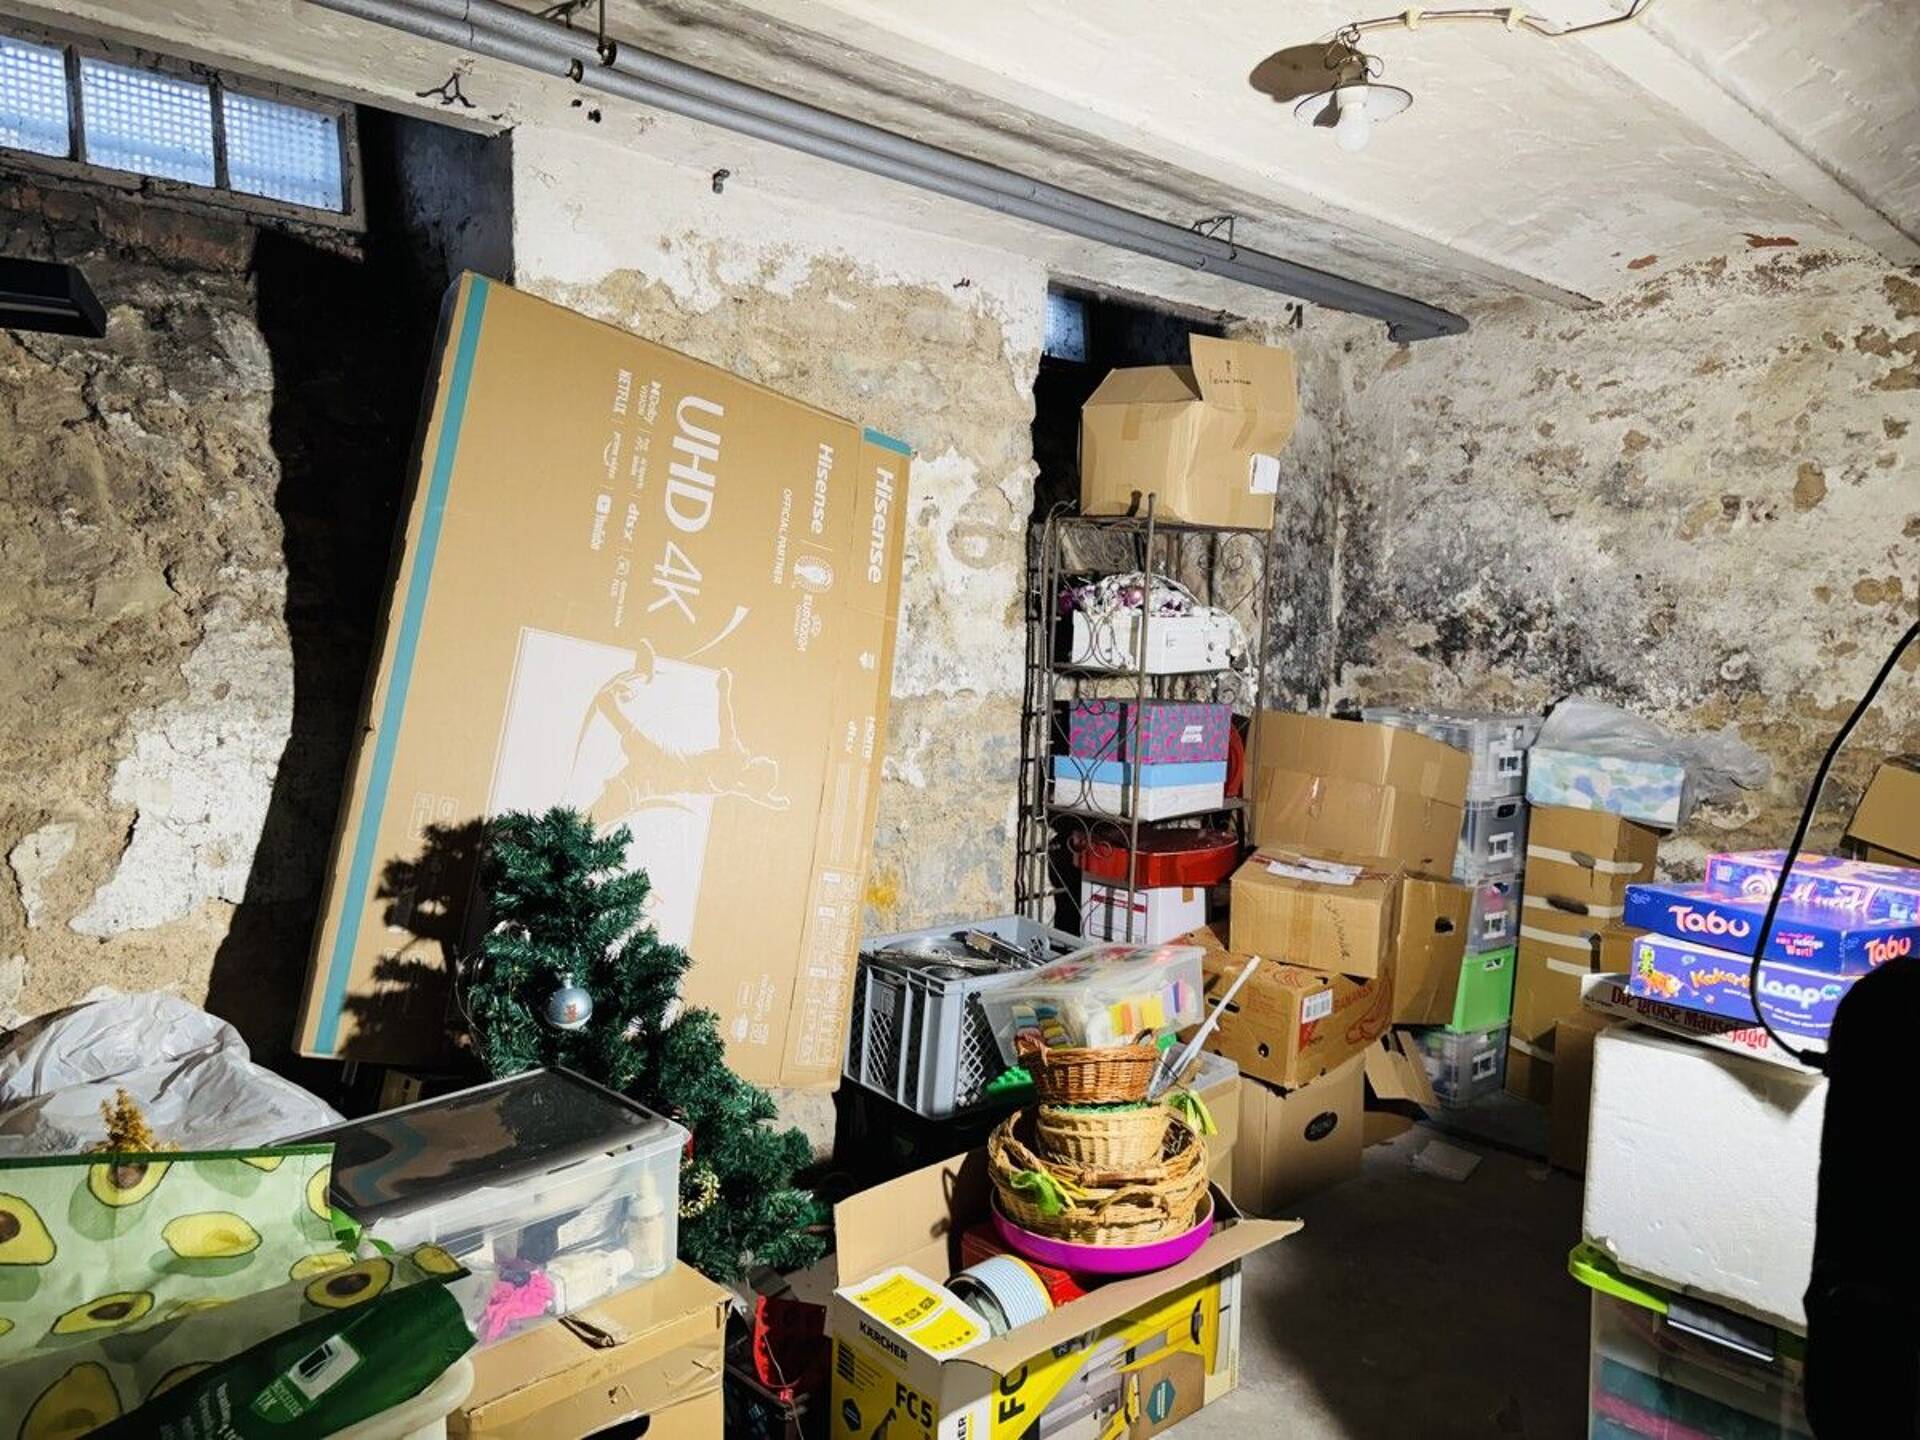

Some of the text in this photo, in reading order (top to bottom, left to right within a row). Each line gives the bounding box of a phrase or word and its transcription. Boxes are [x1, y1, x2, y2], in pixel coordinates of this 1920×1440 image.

[613, 369, 632, 415] NETFLIX
[634, 383, 650, 416] VISION
[647, 396, 724, 624] UHD 4K
[811, 442, 834, 535] Hisense
[773, 488, 793, 585] OFFICIAL PARTNER
[868, 467, 895, 584] Hisense
[1668, 905, 1750, 937] Tabu
[1865, 937, 1912, 966] Tabu
